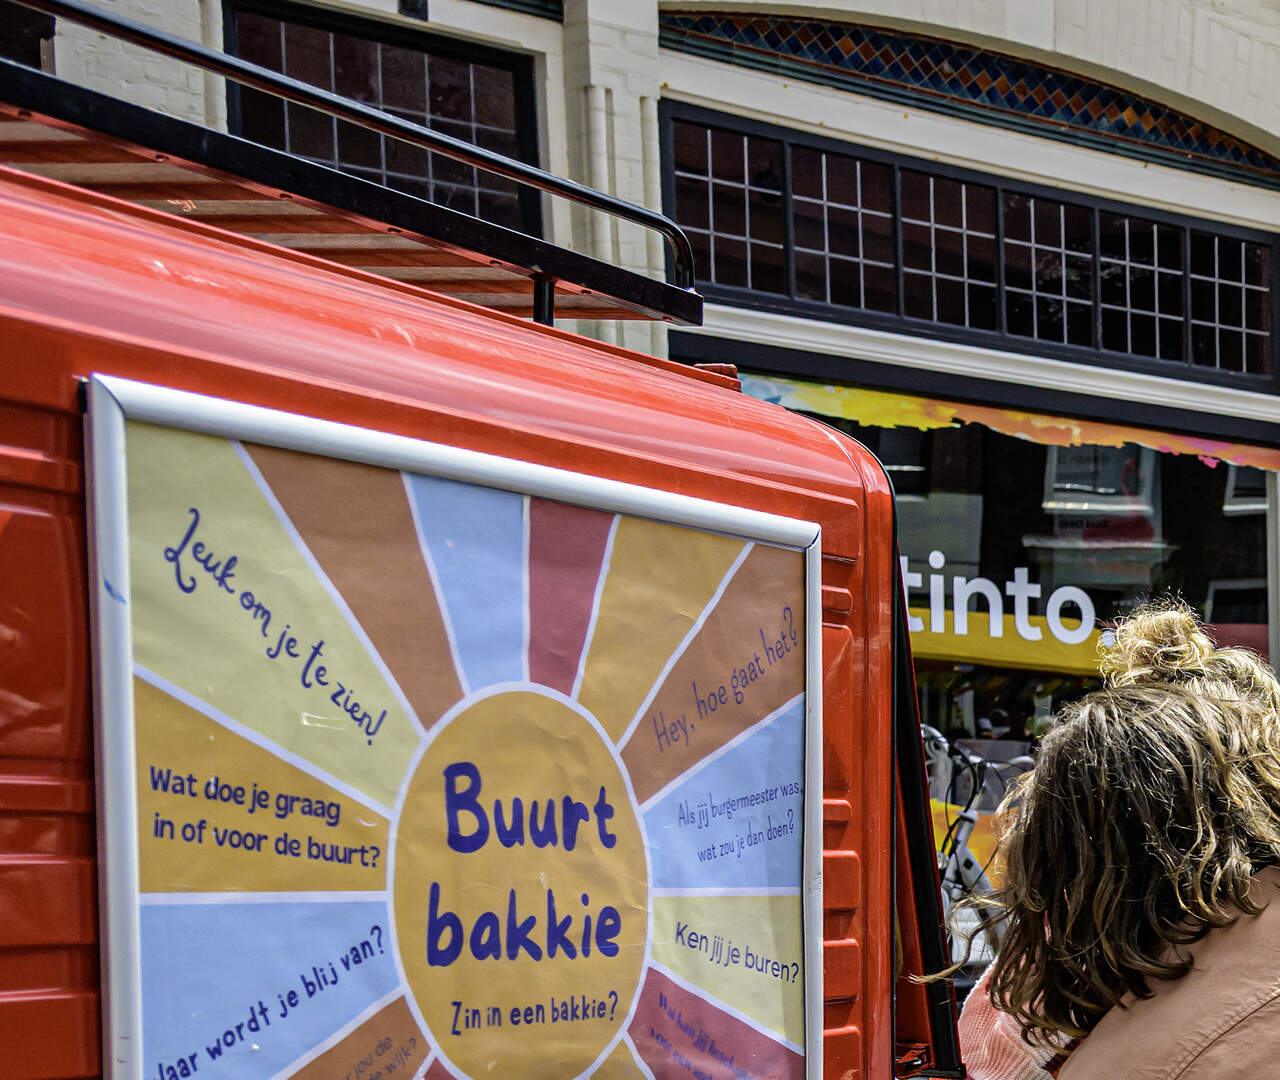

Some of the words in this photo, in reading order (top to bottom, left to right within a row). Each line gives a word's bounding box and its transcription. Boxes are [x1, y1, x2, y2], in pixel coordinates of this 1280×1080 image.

[164, 508, 238, 593] Leuk
[240, 592, 272, 637] om
[266, 625, 299, 659] je
[301, 640, 329, 688] te
[330, 682, 387, 746] zien!
[652, 711, 695, 752] Hey,
[691, 681, 729, 720] hoe
[730, 652, 765, 704] gaat
[759, 606, 798, 666] het?
[150, 766, 198, 798] Wat
[204, 777, 246, 805] doe
[248, 784, 270, 813] je
[275, 792, 341, 827] graag
[443, 762, 617, 853] Buurt
[678, 799, 696, 827] Als
[698, 803, 710, 829] jij
[709, 792, 779, 819] burgermeester
[153, 813, 174, 839] in
[182, 819, 207, 844] of
[213, 827, 267, 852] voor
[274, 833, 301, 857] de
[308, 837, 381, 868] buurt?
[698, 844, 717, 862] wat
[720, 840, 735, 857] zou
[735, 834, 745, 858] je
[747, 821, 765, 847] dan
[767, 809, 794, 841] doen?
[427, 882, 622, 967] bakkie
[675, 921, 709, 952] Ken
[709, 935, 724, 964] jij
[724, 941, 741, 967] je
[745, 945, 799, 983] buren?
[205, 1000, 271, 1062] wordt
[279, 987, 299, 1018] je
[300, 962, 338, 999] blij
[340, 925, 385, 971] van?
[451, 1001, 481, 1036] Zin
[487, 1005, 502, 1027] in
[510, 1001, 545, 1026] een
[551, 990, 619, 1023] bakkie?
[353, 1053, 375, 1080] jou
[375, 1037, 393, 1057] de
[385, 1037, 417, 1073] wijk?
